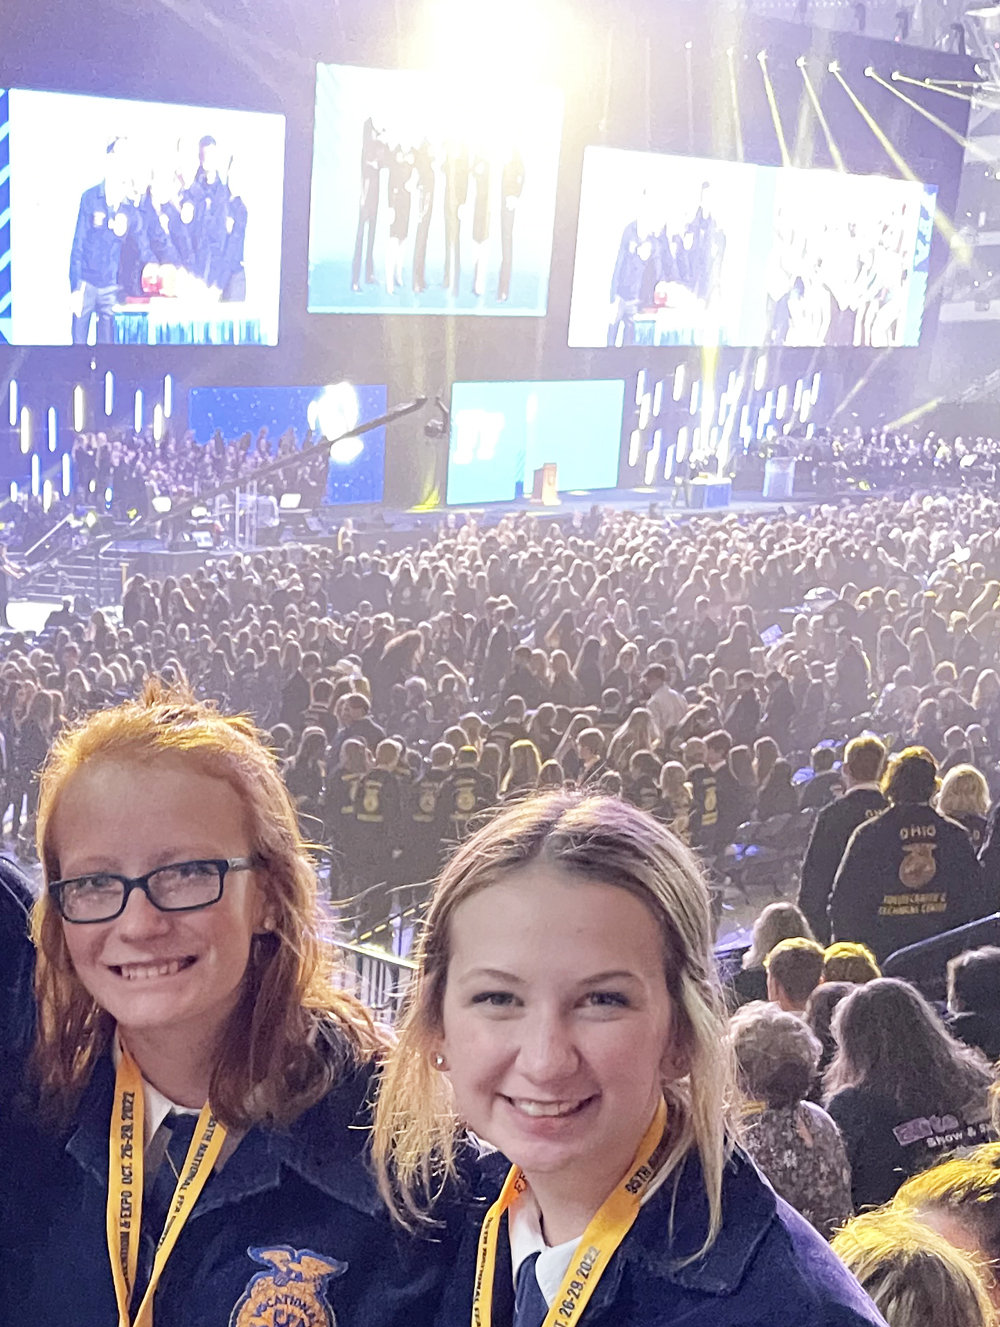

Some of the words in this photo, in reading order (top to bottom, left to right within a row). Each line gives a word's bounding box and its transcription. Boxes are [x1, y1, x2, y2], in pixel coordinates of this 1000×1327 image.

[900, 825, 936, 840] OHIO
[121, 1091, 135, 1121] 2022
[179, 1142, 208, 1191] NATIONAL
[120, 1191, 132, 1218] EXPO
[174, 1194, 185, 1213] FFA
[576, 1246, 601, 1279] 2022
